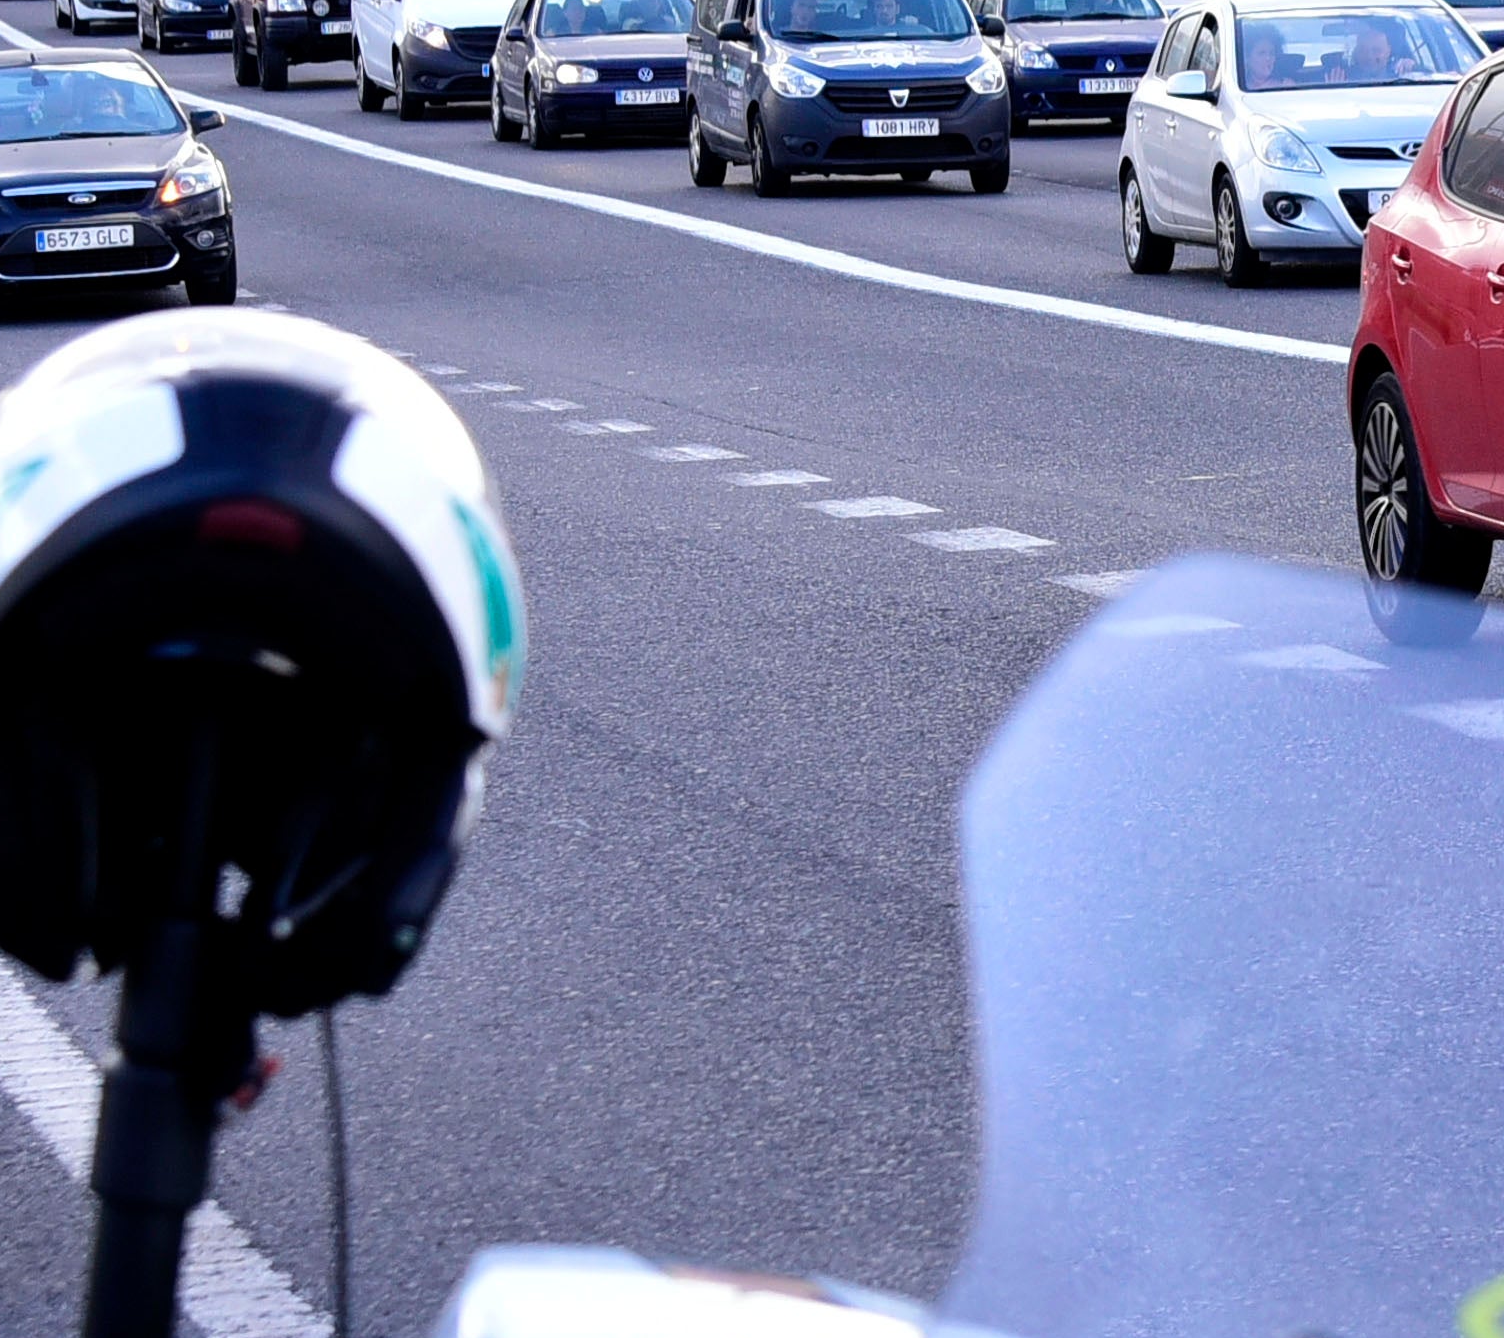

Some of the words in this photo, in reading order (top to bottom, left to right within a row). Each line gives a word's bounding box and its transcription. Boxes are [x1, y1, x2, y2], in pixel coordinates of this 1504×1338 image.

[1089, 79, 1116, 92] 1333
[623, 91, 651, 103] 4317
[874, 120, 905, 134] 1081
[907, 119, 936, 134] HRY
[46, 230, 92, 249] 6573
[95, 227, 130, 246] GLC
